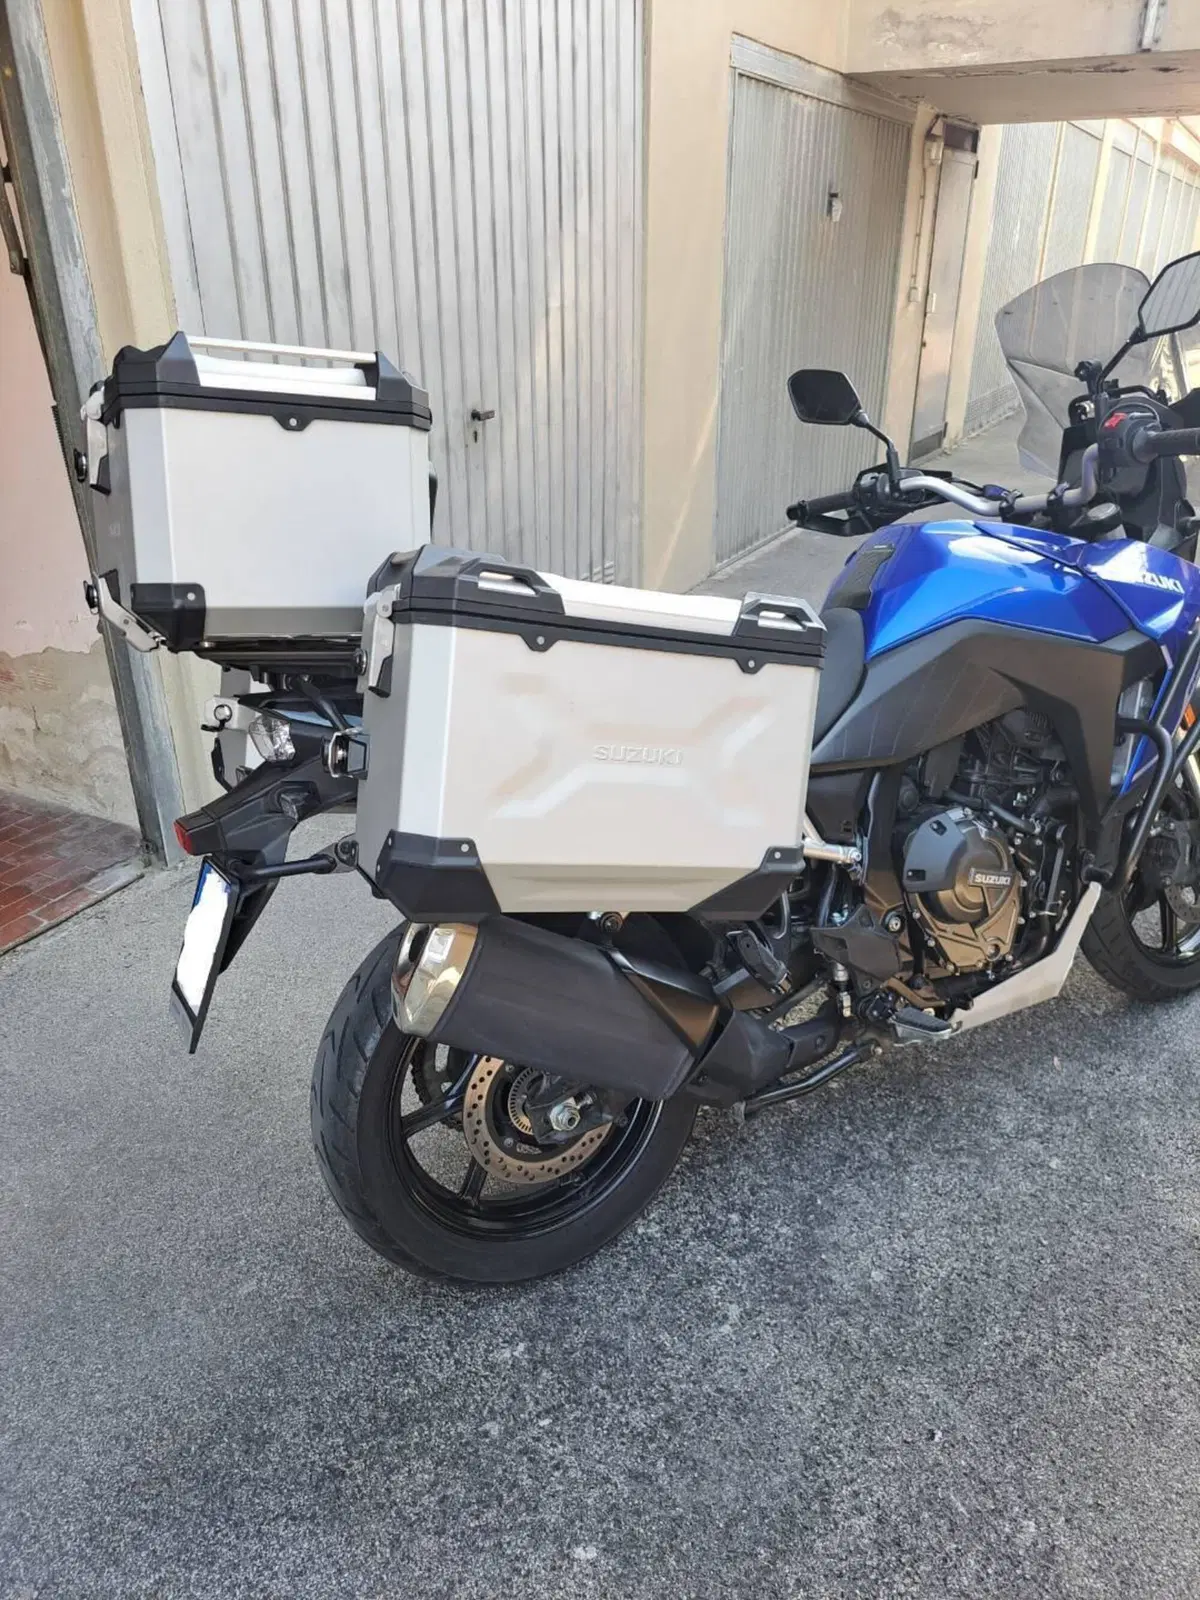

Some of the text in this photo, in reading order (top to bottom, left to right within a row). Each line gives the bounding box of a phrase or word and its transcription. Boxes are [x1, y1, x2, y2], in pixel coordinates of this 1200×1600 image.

[1134, 571, 1185, 594] ZUKI
[592, 743, 684, 766] SUZUKI
[974, 873, 1011, 886] SUZUKI
